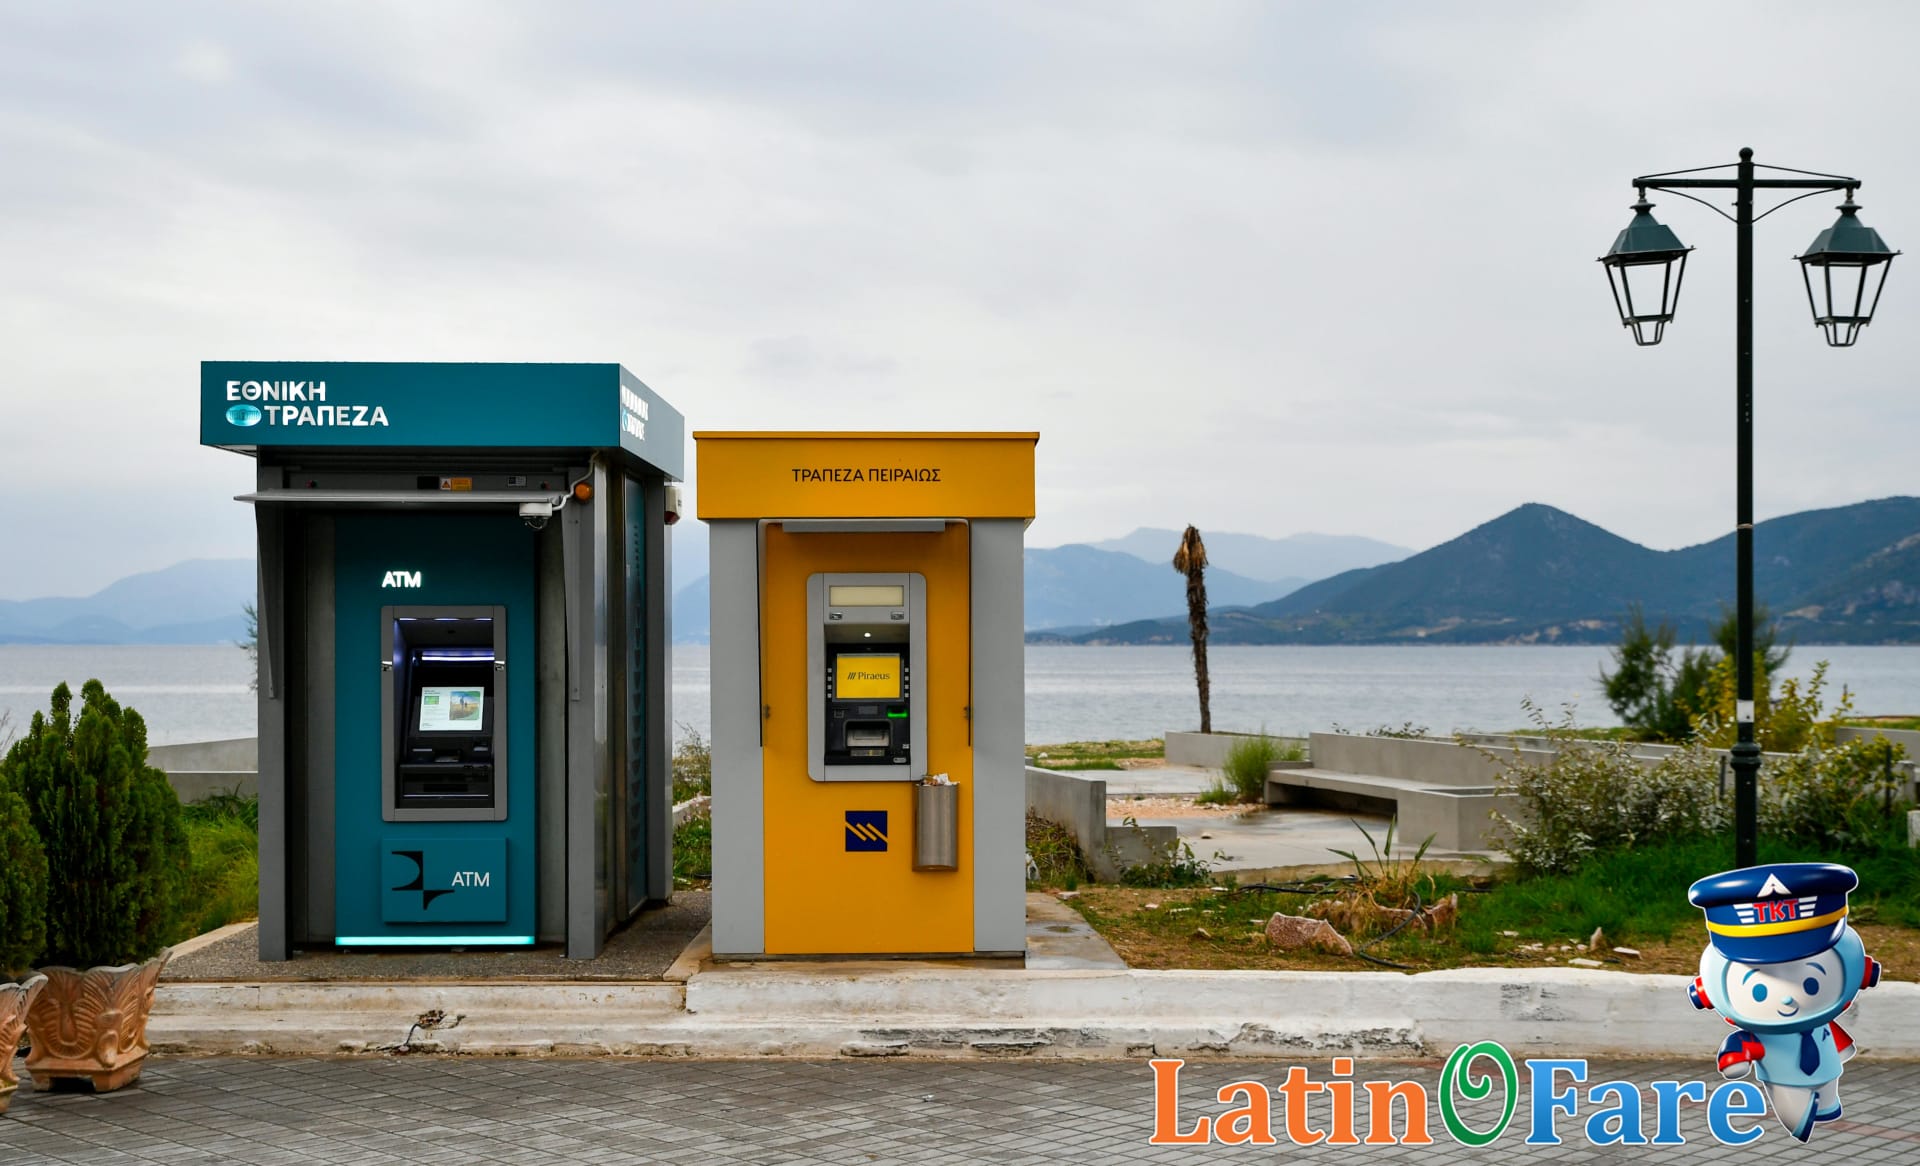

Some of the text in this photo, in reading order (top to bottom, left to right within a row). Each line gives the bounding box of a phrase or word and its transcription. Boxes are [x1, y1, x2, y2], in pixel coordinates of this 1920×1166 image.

[226, 380, 326, 401] ΕΘΝΙΚΗ
[263, 405, 389, 426] ΤΡΑΠΕΖΑ
[792, 468, 941, 482] ΤΡΑΠΕΖΑ ΠΕΙΡΑΙΩΣ
[381, 571, 422, 588] ATM
[857, 671, 890, 681] Piraeus
[451, 871, 490, 887] ATM
